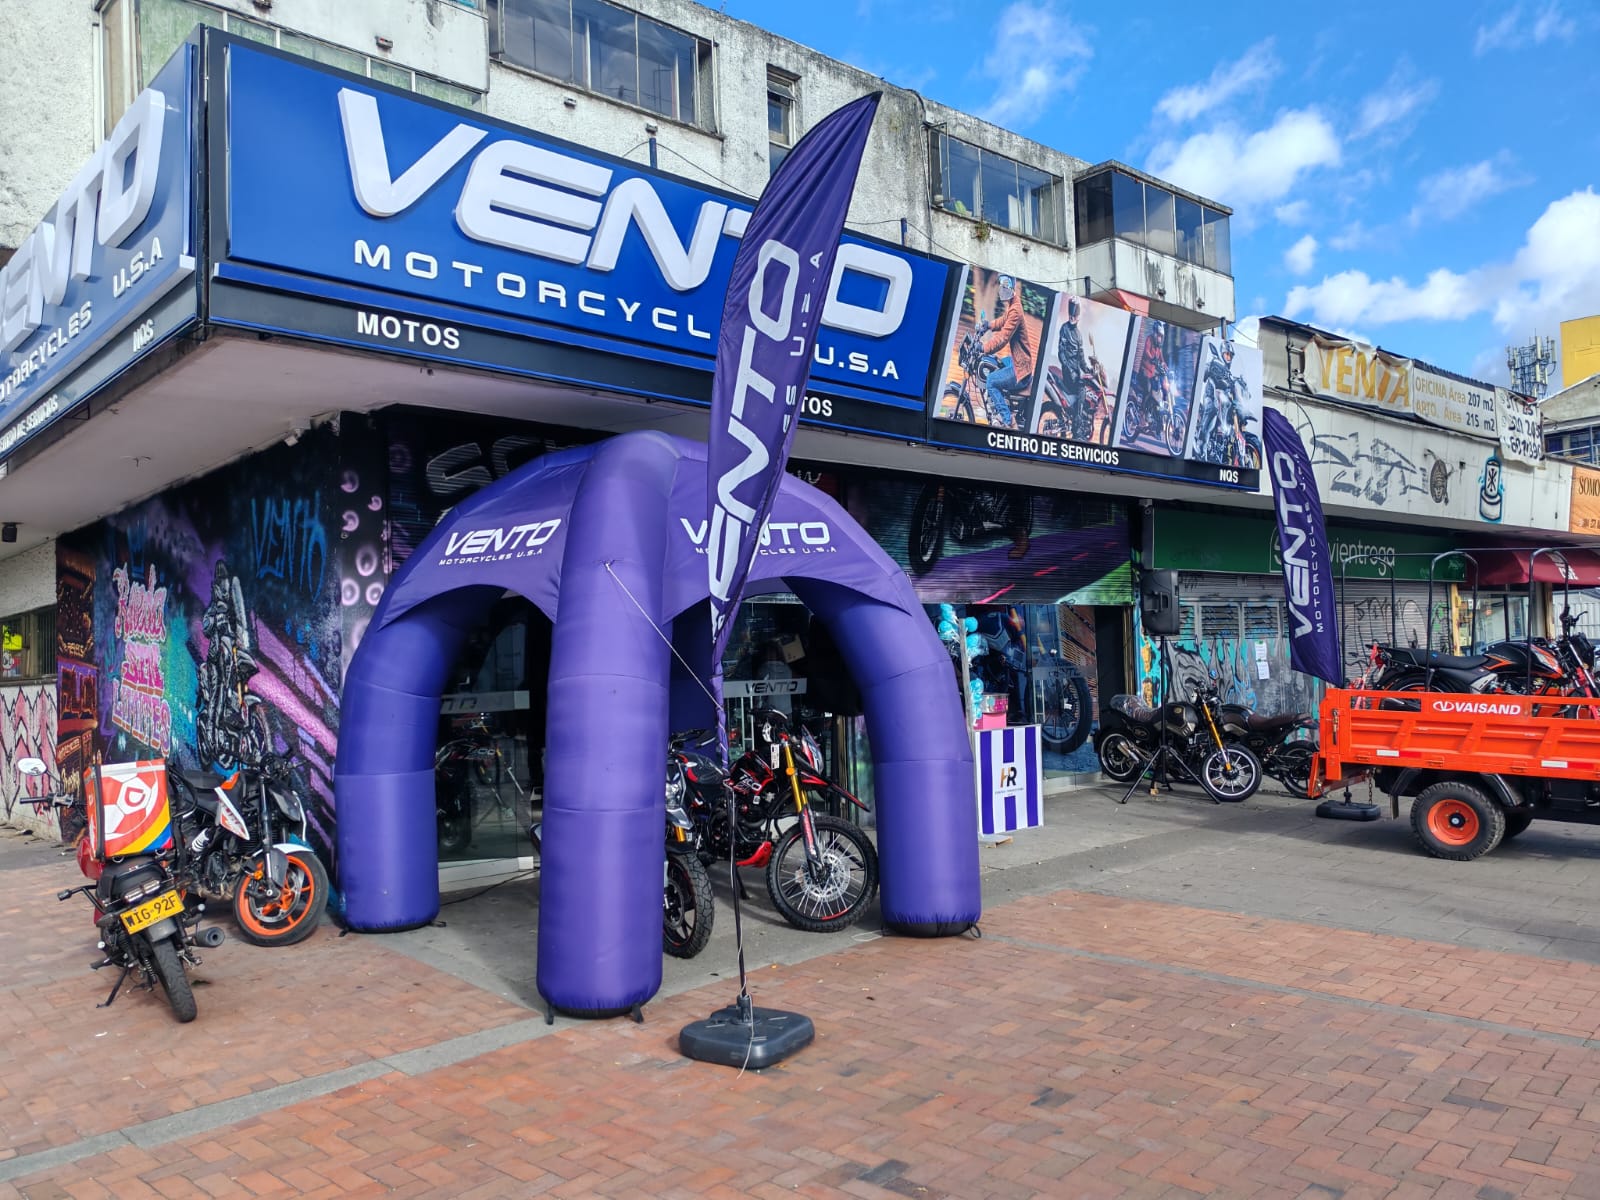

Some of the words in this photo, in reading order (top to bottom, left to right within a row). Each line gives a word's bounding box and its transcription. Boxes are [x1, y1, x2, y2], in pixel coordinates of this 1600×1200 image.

[0, 87, 165, 352] ENTO
[337, 87, 913, 338] VENO
[112, 236, 164, 298] U.S.A
[354, 239, 711, 341] MOTORCYCL
[814, 343, 899, 380] U.S.A
[357, 311, 461, 350] MOTOS
[800, 396, 833, 417] TOS
[1415, 376, 1447, 396] OFICINA
[1467, 391, 1481, 407] 207
[1482, 398, 1494, 412] m2
[1466, 412, 1480, 428] 215
[1483, 418, 1495, 432] m2
[987, 432, 1038, 454] CENTRO
[1041, 442, 1058, 457] DE
[1060, 443, 1119, 465] SERVICIOS
[1219, 469, 1239, 483] NQS
[445, 518, 562, 556] VENTO
[680, 518, 831, 546] VTO
[1273, 450, 1313, 639] VENTO
[438, 553, 512, 566] MOTORCYCLES
[516, 548, 543, 558] U.S.A
[802, 546, 837, 554] U.S.A
[745, 680, 799, 695] VENTO
[1455, 702, 1521, 715] VAISAND
